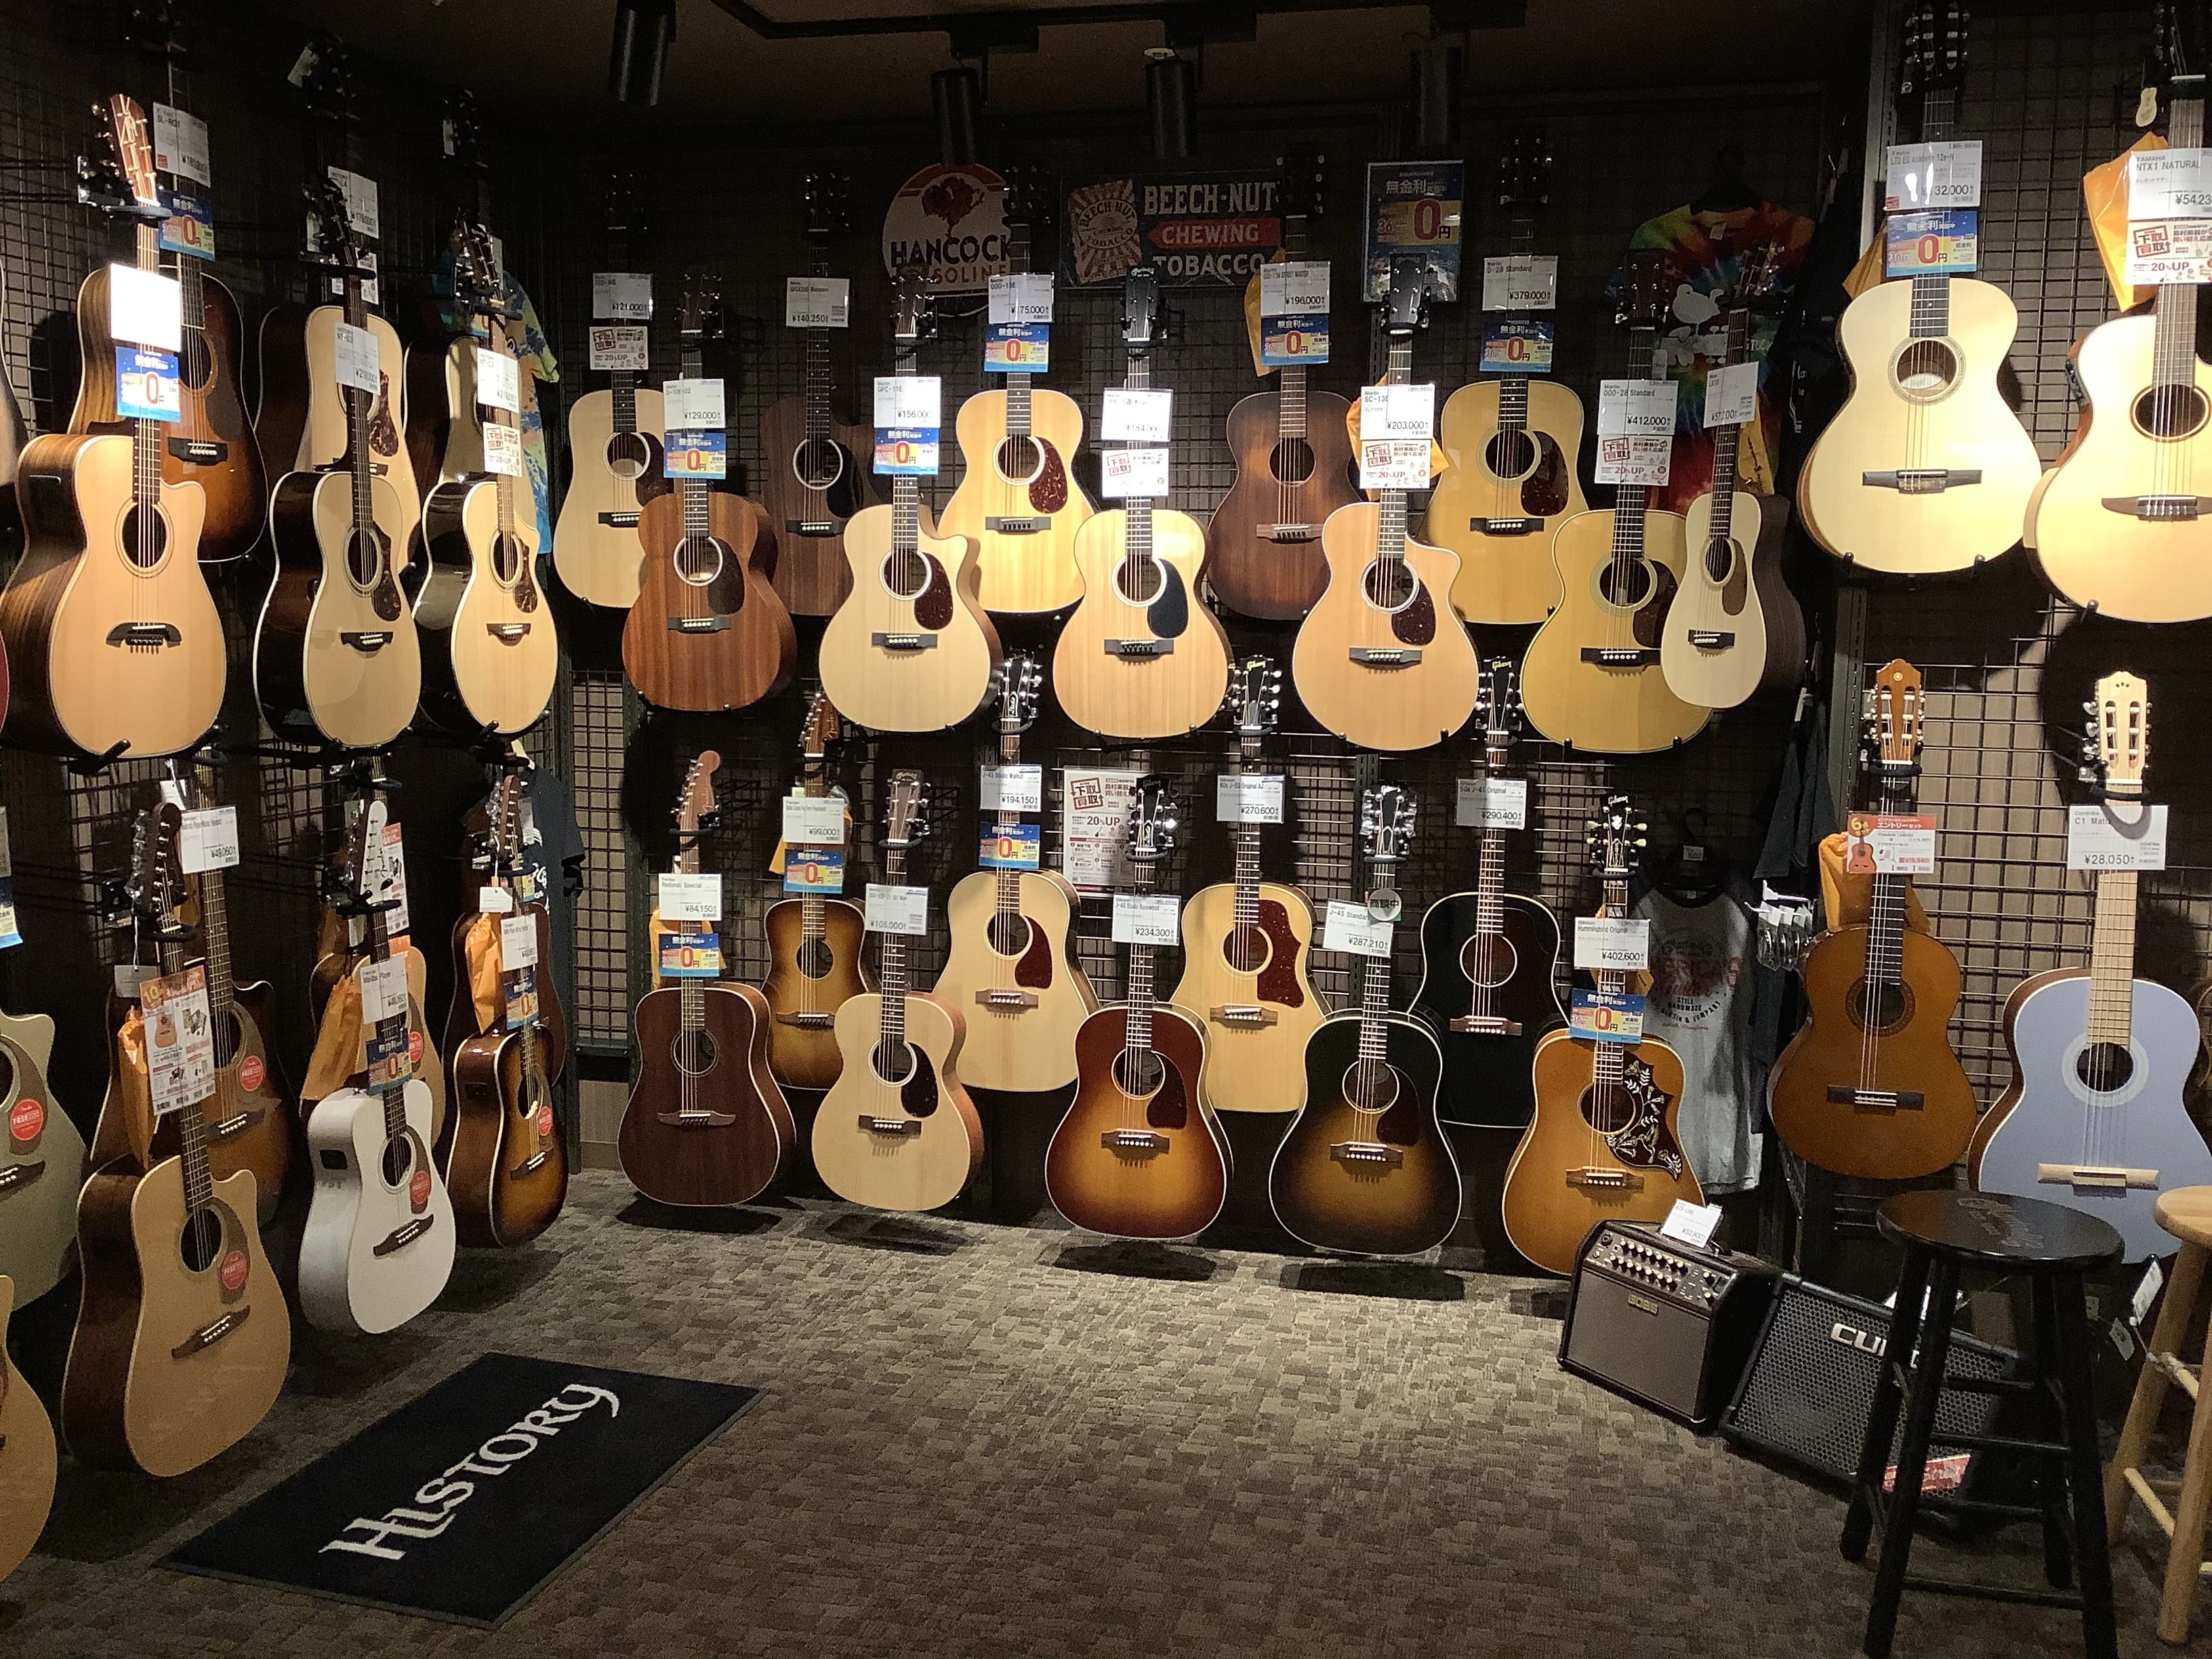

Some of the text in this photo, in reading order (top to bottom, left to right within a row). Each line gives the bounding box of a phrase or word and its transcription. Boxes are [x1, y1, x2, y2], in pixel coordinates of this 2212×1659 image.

[2136, 155, 2166, 163] YAMAHA
[2161, 161, 2200, 171] NATURAL
[1414, 199, 1451, 241] 0円
[1162, 224, 1259, 245] CHEWING
[2138, 232, 2163, 245] 下取
[890, 234, 1008, 268] HANCOCK
[1918, 235, 1948, 264] 0円
[1151, 253, 1265, 277] TOBACCO
[1506, 265, 1533, 274] Standard
[1285, 295, 1322, 306] ¥196,000
[1509, 291, 1547, 300] ¥379,000
[1010, 305, 1045, 314] ¥75,000
[1286, 332, 1309, 354] 0円
[1006, 339, 1027, 363] 0円
[1508, 337, 1530, 362] 0円
[1630, 390, 1656, 398] Standard
[684, 411, 718, 420] ¥129,000
[1387, 421, 1425, 430] ¥203,000
[1627, 417, 1667, 426] ¥412,000
[895, 441, 916, 464] 0円
[1369, 448, 1387, 457] 下取
[686, 449, 707, 472] 0円
[1075, 785, 1097, 796] 下取
[1487, 787, 1507, 796] Original
[1001, 795, 1035, 804] ¥194,150
[1078, 794, 1099, 806] 買取
[1240, 806, 1275, 815] ¥270,600
[1481, 811, 1518, 821] ¥290,400
[1086, 816, 1120, 826] 20%UP
[2074, 817, 2085, 825] C1
[808, 828, 836, 836] ¥99,000
[999, 837, 1019, 859] 0円
[2083, 854, 2129, 865] ¥28,050
[804, 863, 824, 884] 0円
[683, 882, 703, 890] Special
[685, 905, 714, 914] ¥84,150
[1329, 909, 1369, 921] J-45 Standar
[870, 920, 903, 930] ¥105,000
[1577, 926, 1629, 935] Hummingbird Original
[1134, 928, 1171, 938] ¥234,300
[1348, 936, 1385, 950] ¥287,210
[680, 947, 700, 969] 0円
[1601, 951, 1641, 962] ¥402,600
[1594, 1006, 1618, 1032] 0円
[1628, 1294, 1658, 1315] BOSS
[318, 1382, 621, 1562] HISTORY
